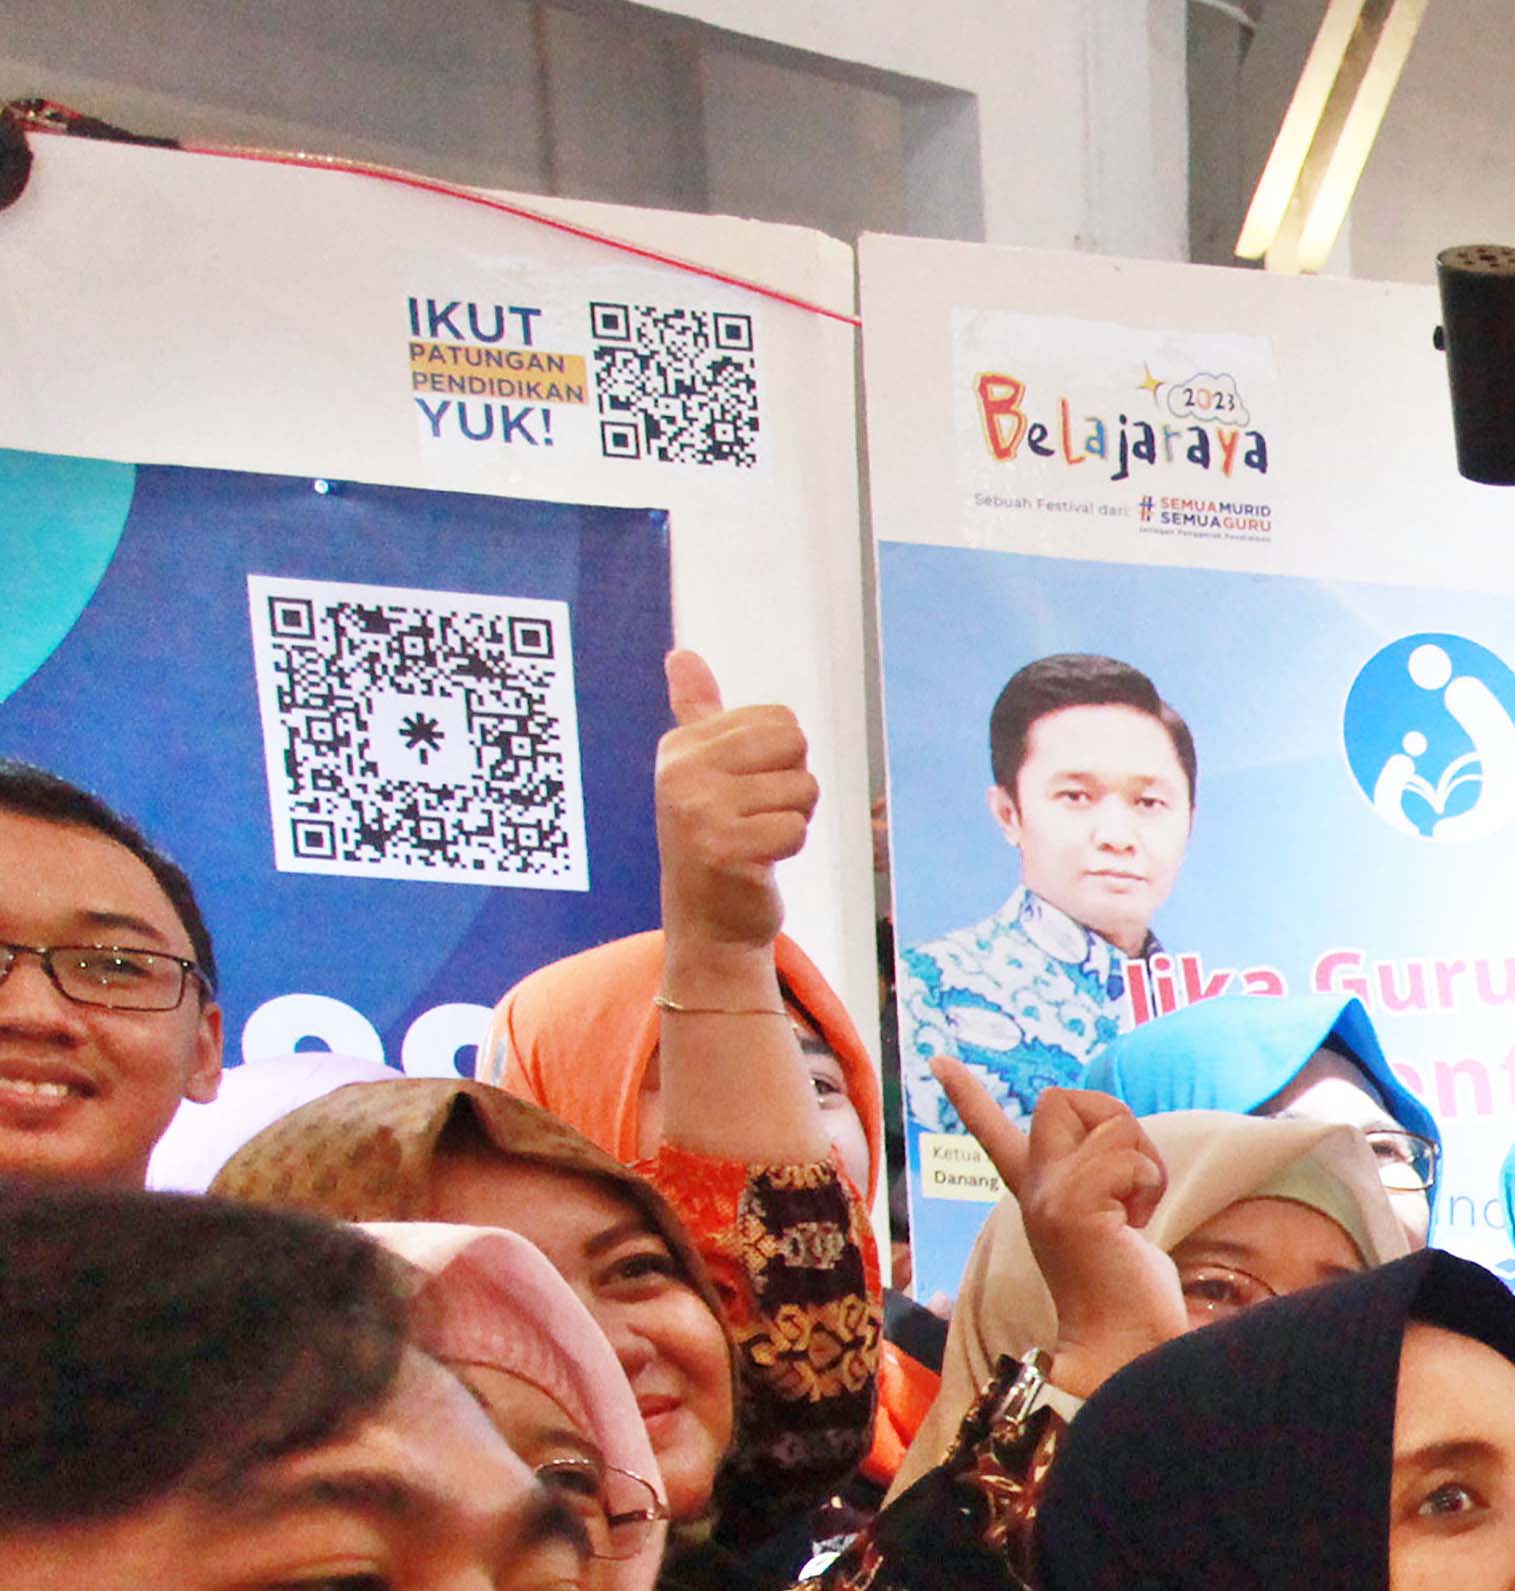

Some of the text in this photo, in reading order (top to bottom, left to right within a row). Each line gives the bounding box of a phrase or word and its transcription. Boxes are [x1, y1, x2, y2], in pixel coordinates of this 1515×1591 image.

[407, 296, 542, 346] IKUT
[409, 343, 566, 375] PATUNGAN
[411, 371, 585, 404] PENDIDIKAN
[1183, 387, 1237, 413] 2023
[415, 397, 556, 447] YUK!
[973, 371, 1268, 481] Belajaraya
[932, 1146, 982, 1163] Ketua
